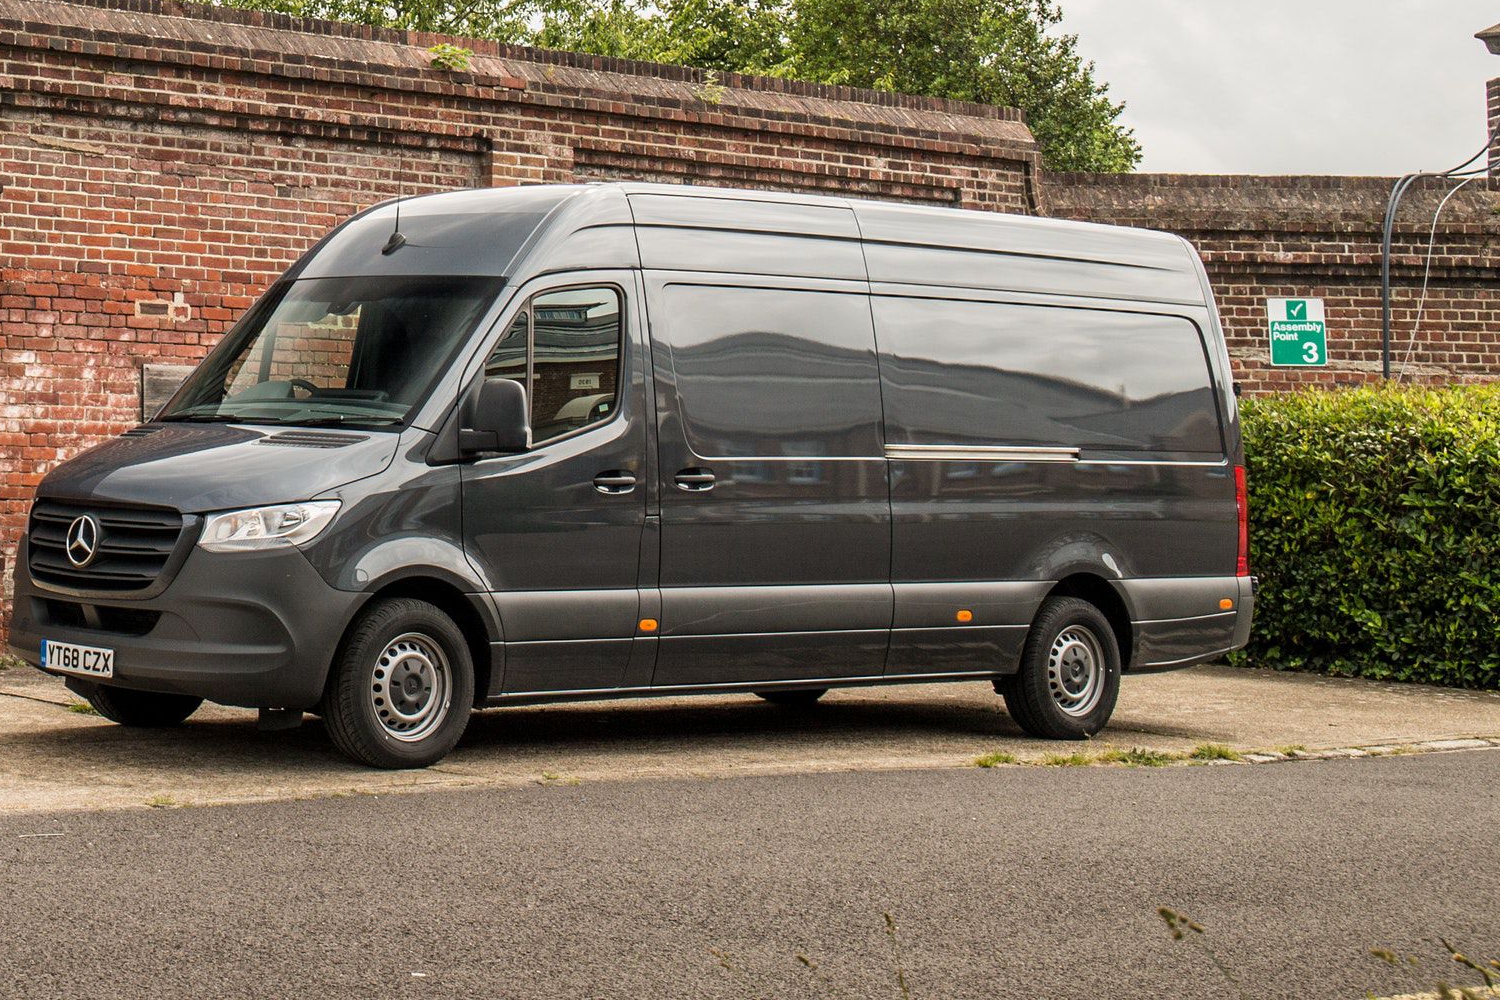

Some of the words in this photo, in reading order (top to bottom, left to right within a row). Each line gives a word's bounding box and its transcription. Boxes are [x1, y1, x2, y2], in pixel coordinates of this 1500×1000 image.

[1273, 322, 1322, 334] Assembly
[1273, 332, 1299, 341] Point
[1302, 341, 1319, 363] 3
[48, 644, 80, 668] YT68
[83, 650, 111, 673] CZX
